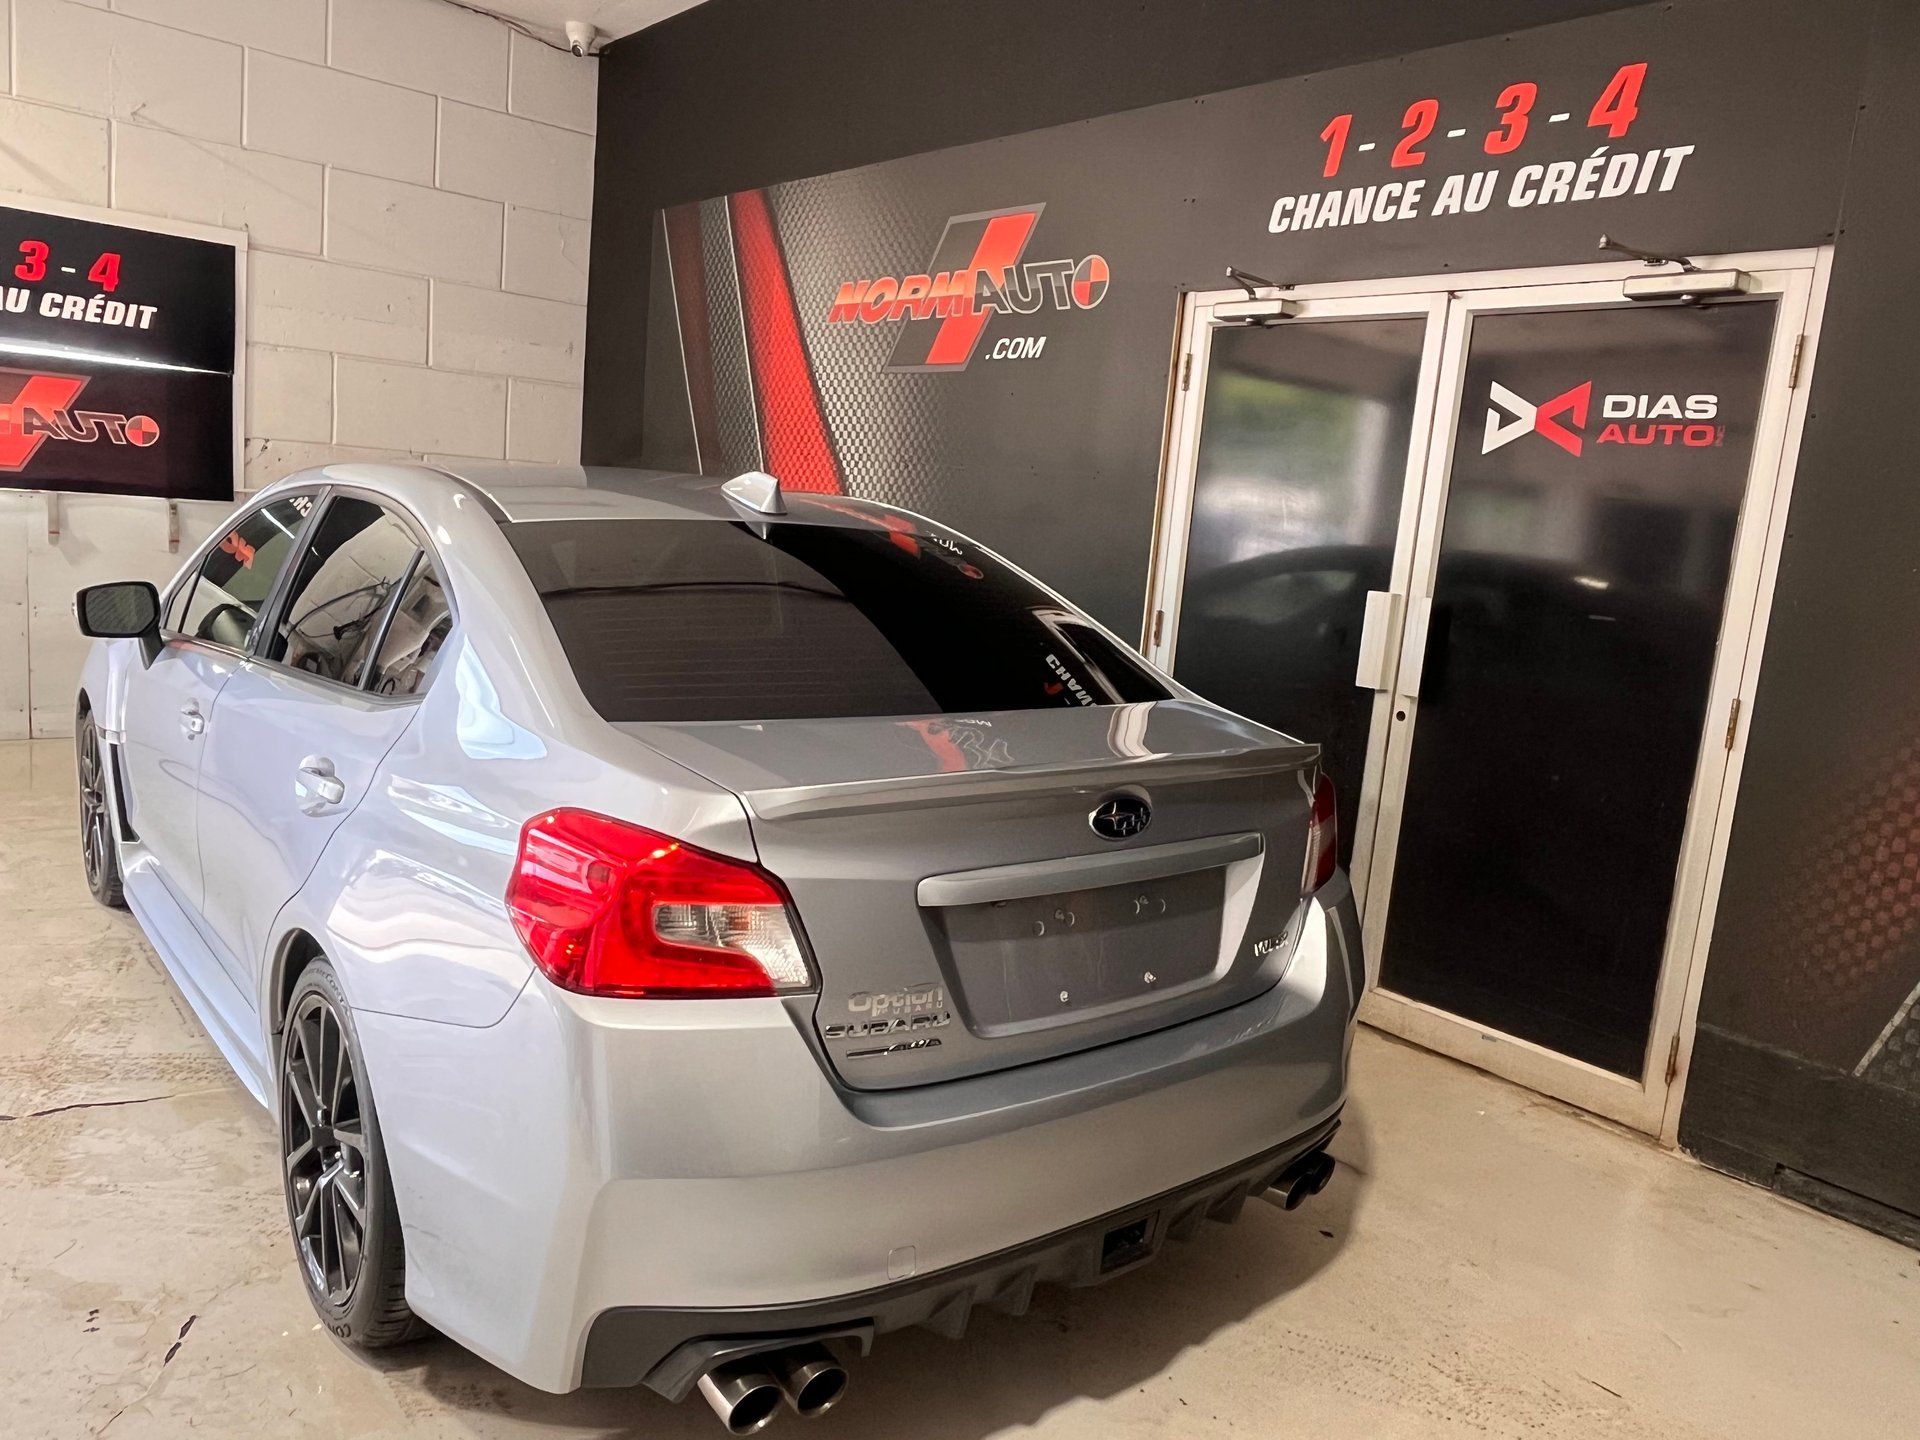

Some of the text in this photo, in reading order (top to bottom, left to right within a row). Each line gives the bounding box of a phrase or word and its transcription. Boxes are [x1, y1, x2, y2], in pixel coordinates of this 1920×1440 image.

[1267, 144, 1696, 234] CHANCE AU CRÉDIT
[0, 285, 158, 330] U CRÉDIT
[984, 336, 1047, 361] .COM
[1602, 394, 1719, 419] DIAS
[1596, 423, 1717, 448] AUTO
[825, 1011, 951, 1039] SUBARU
